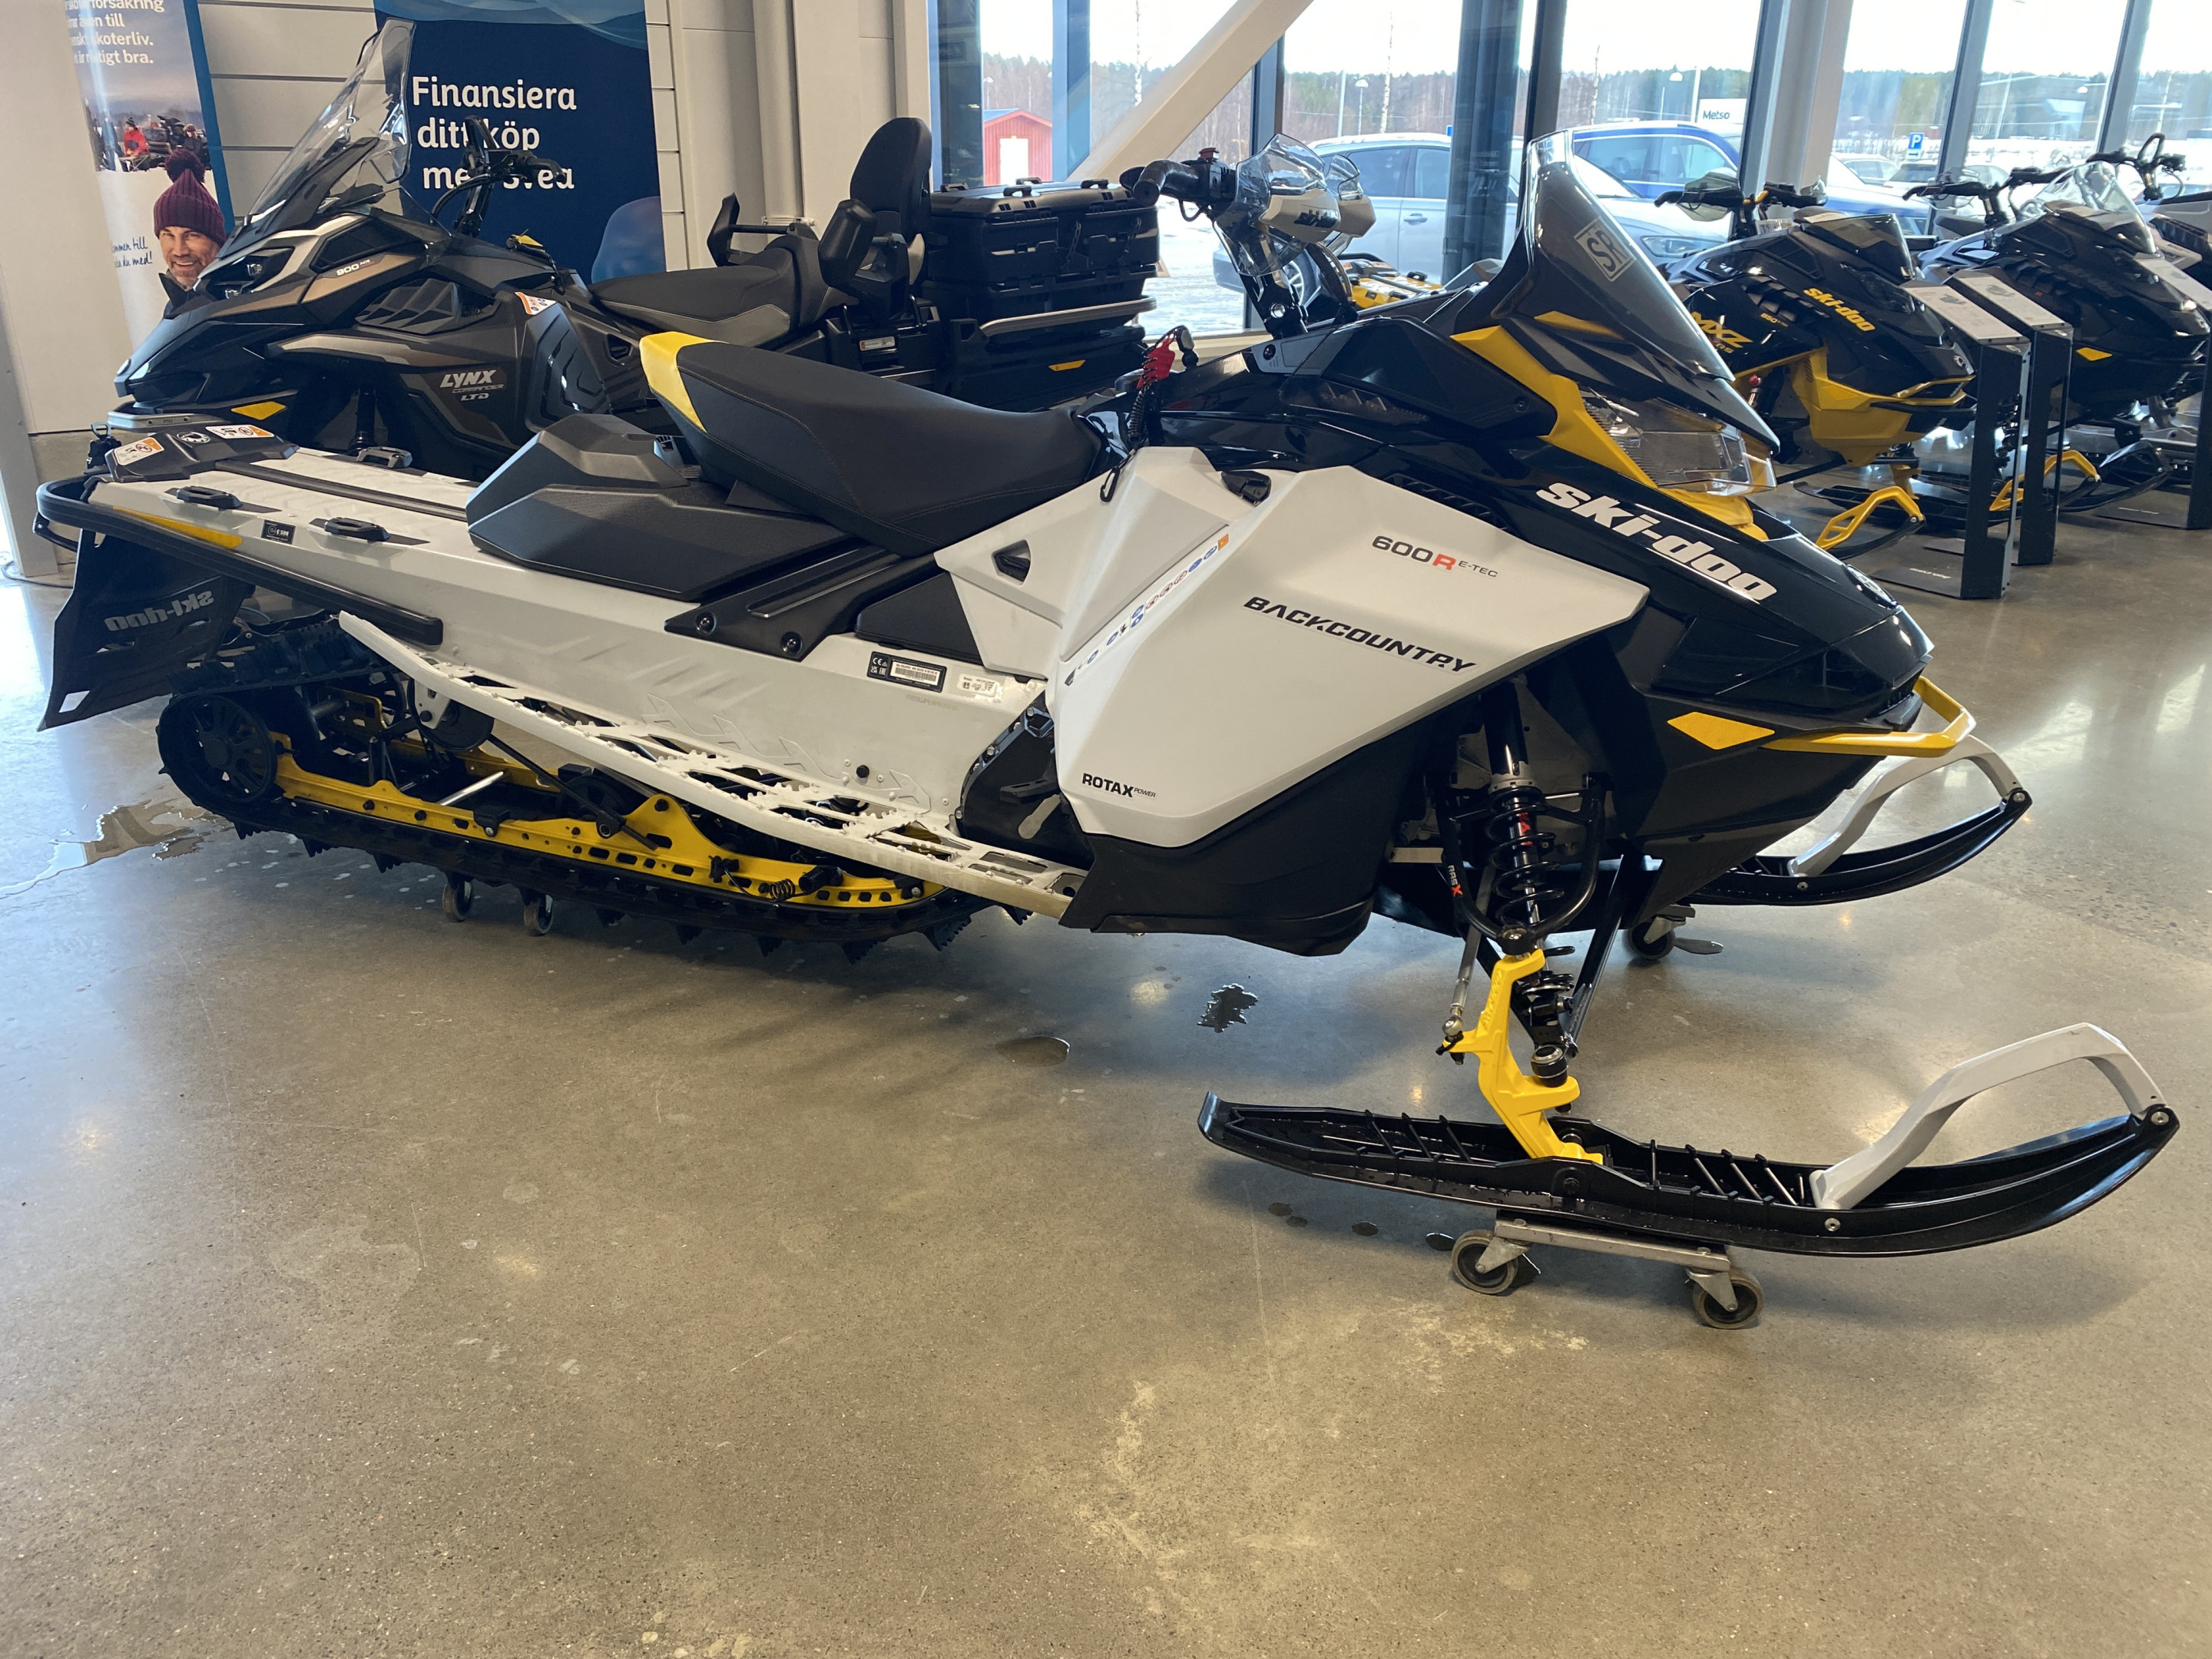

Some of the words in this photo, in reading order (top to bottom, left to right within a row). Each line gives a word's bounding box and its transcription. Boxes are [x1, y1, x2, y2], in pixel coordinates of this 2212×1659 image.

[104, 13, 125, 27] till
[123, 49, 154, 63] bra.
[412, 75, 577, 110] Finansiera
[1703, 110, 1730, 120] Metso
[1911, 134, 1922, 148] P
[132, 250, 153, 266] med!
[1803, 287, 1876, 332] ski-doo
[439, 369, 497, 389] LYNX
[461, 392, 490, 402] LTD
[1535, 482, 1777, 601] ski-doo
[1372, 535, 1456, 571] 600R
[1458, 560, 1498, 578] E-TEC
[1243, 596, 1477, 672] BACKCOUNTRY
[1081, 772, 1134, 798] ROTAX
[1134, 787, 1157, 798] POWER
